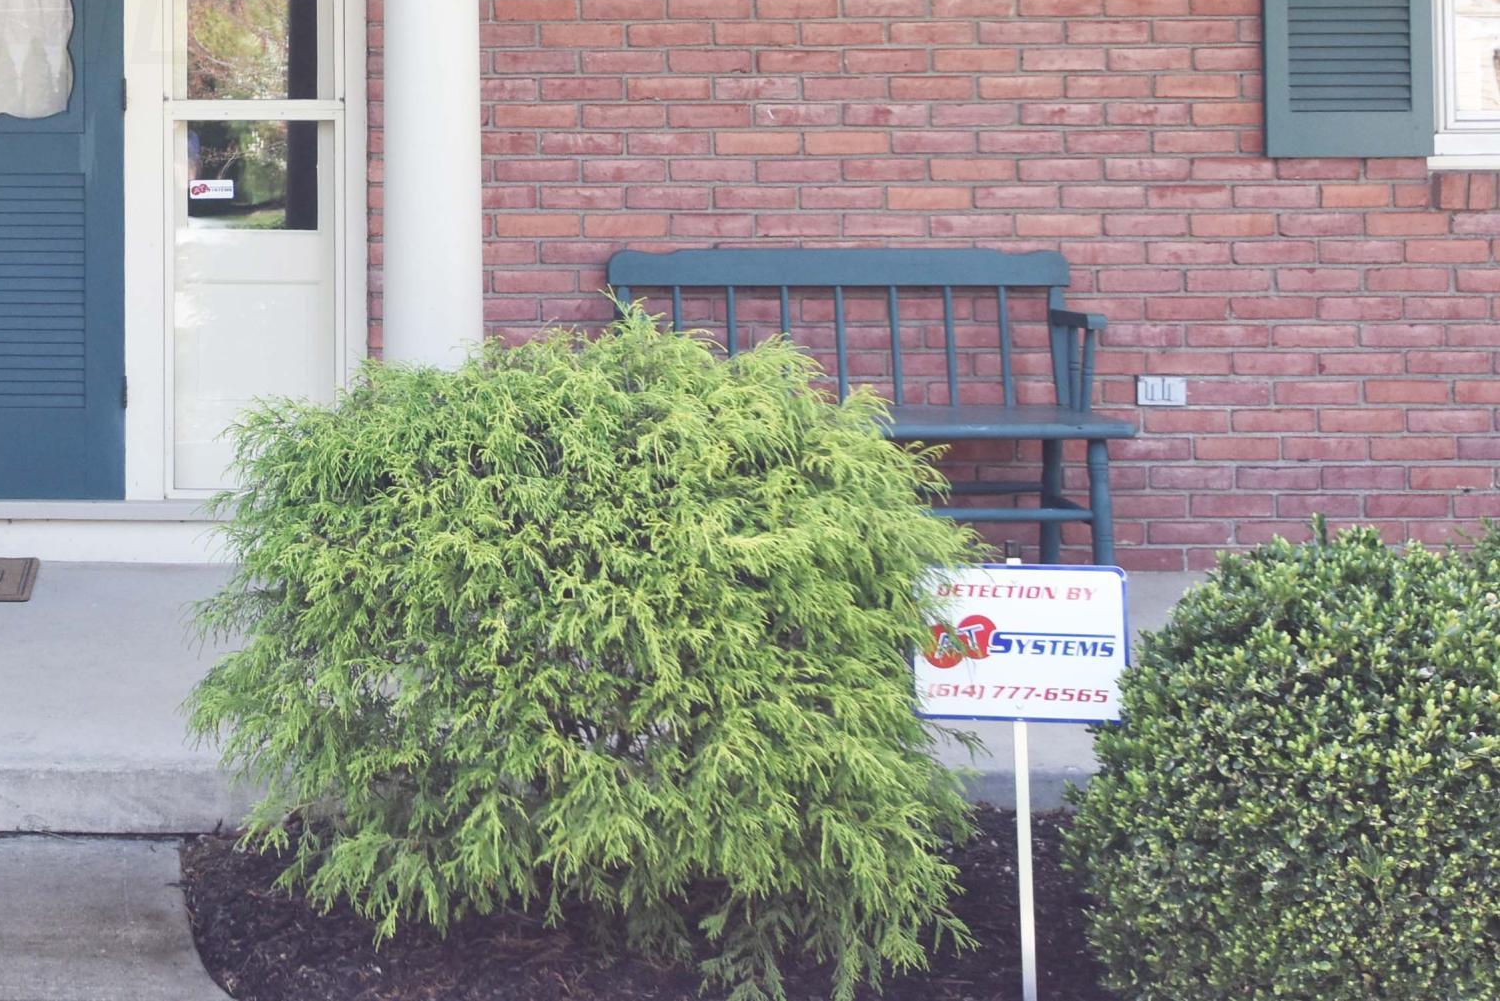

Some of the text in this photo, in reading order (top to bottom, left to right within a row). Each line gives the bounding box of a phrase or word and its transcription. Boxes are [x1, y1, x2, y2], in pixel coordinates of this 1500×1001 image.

[937, 583, 1097, 601] DETECTION BY
[989, 631, 1116, 658] SYSTEMS
[927, 683, 1110, 704] (614) 777-6565
